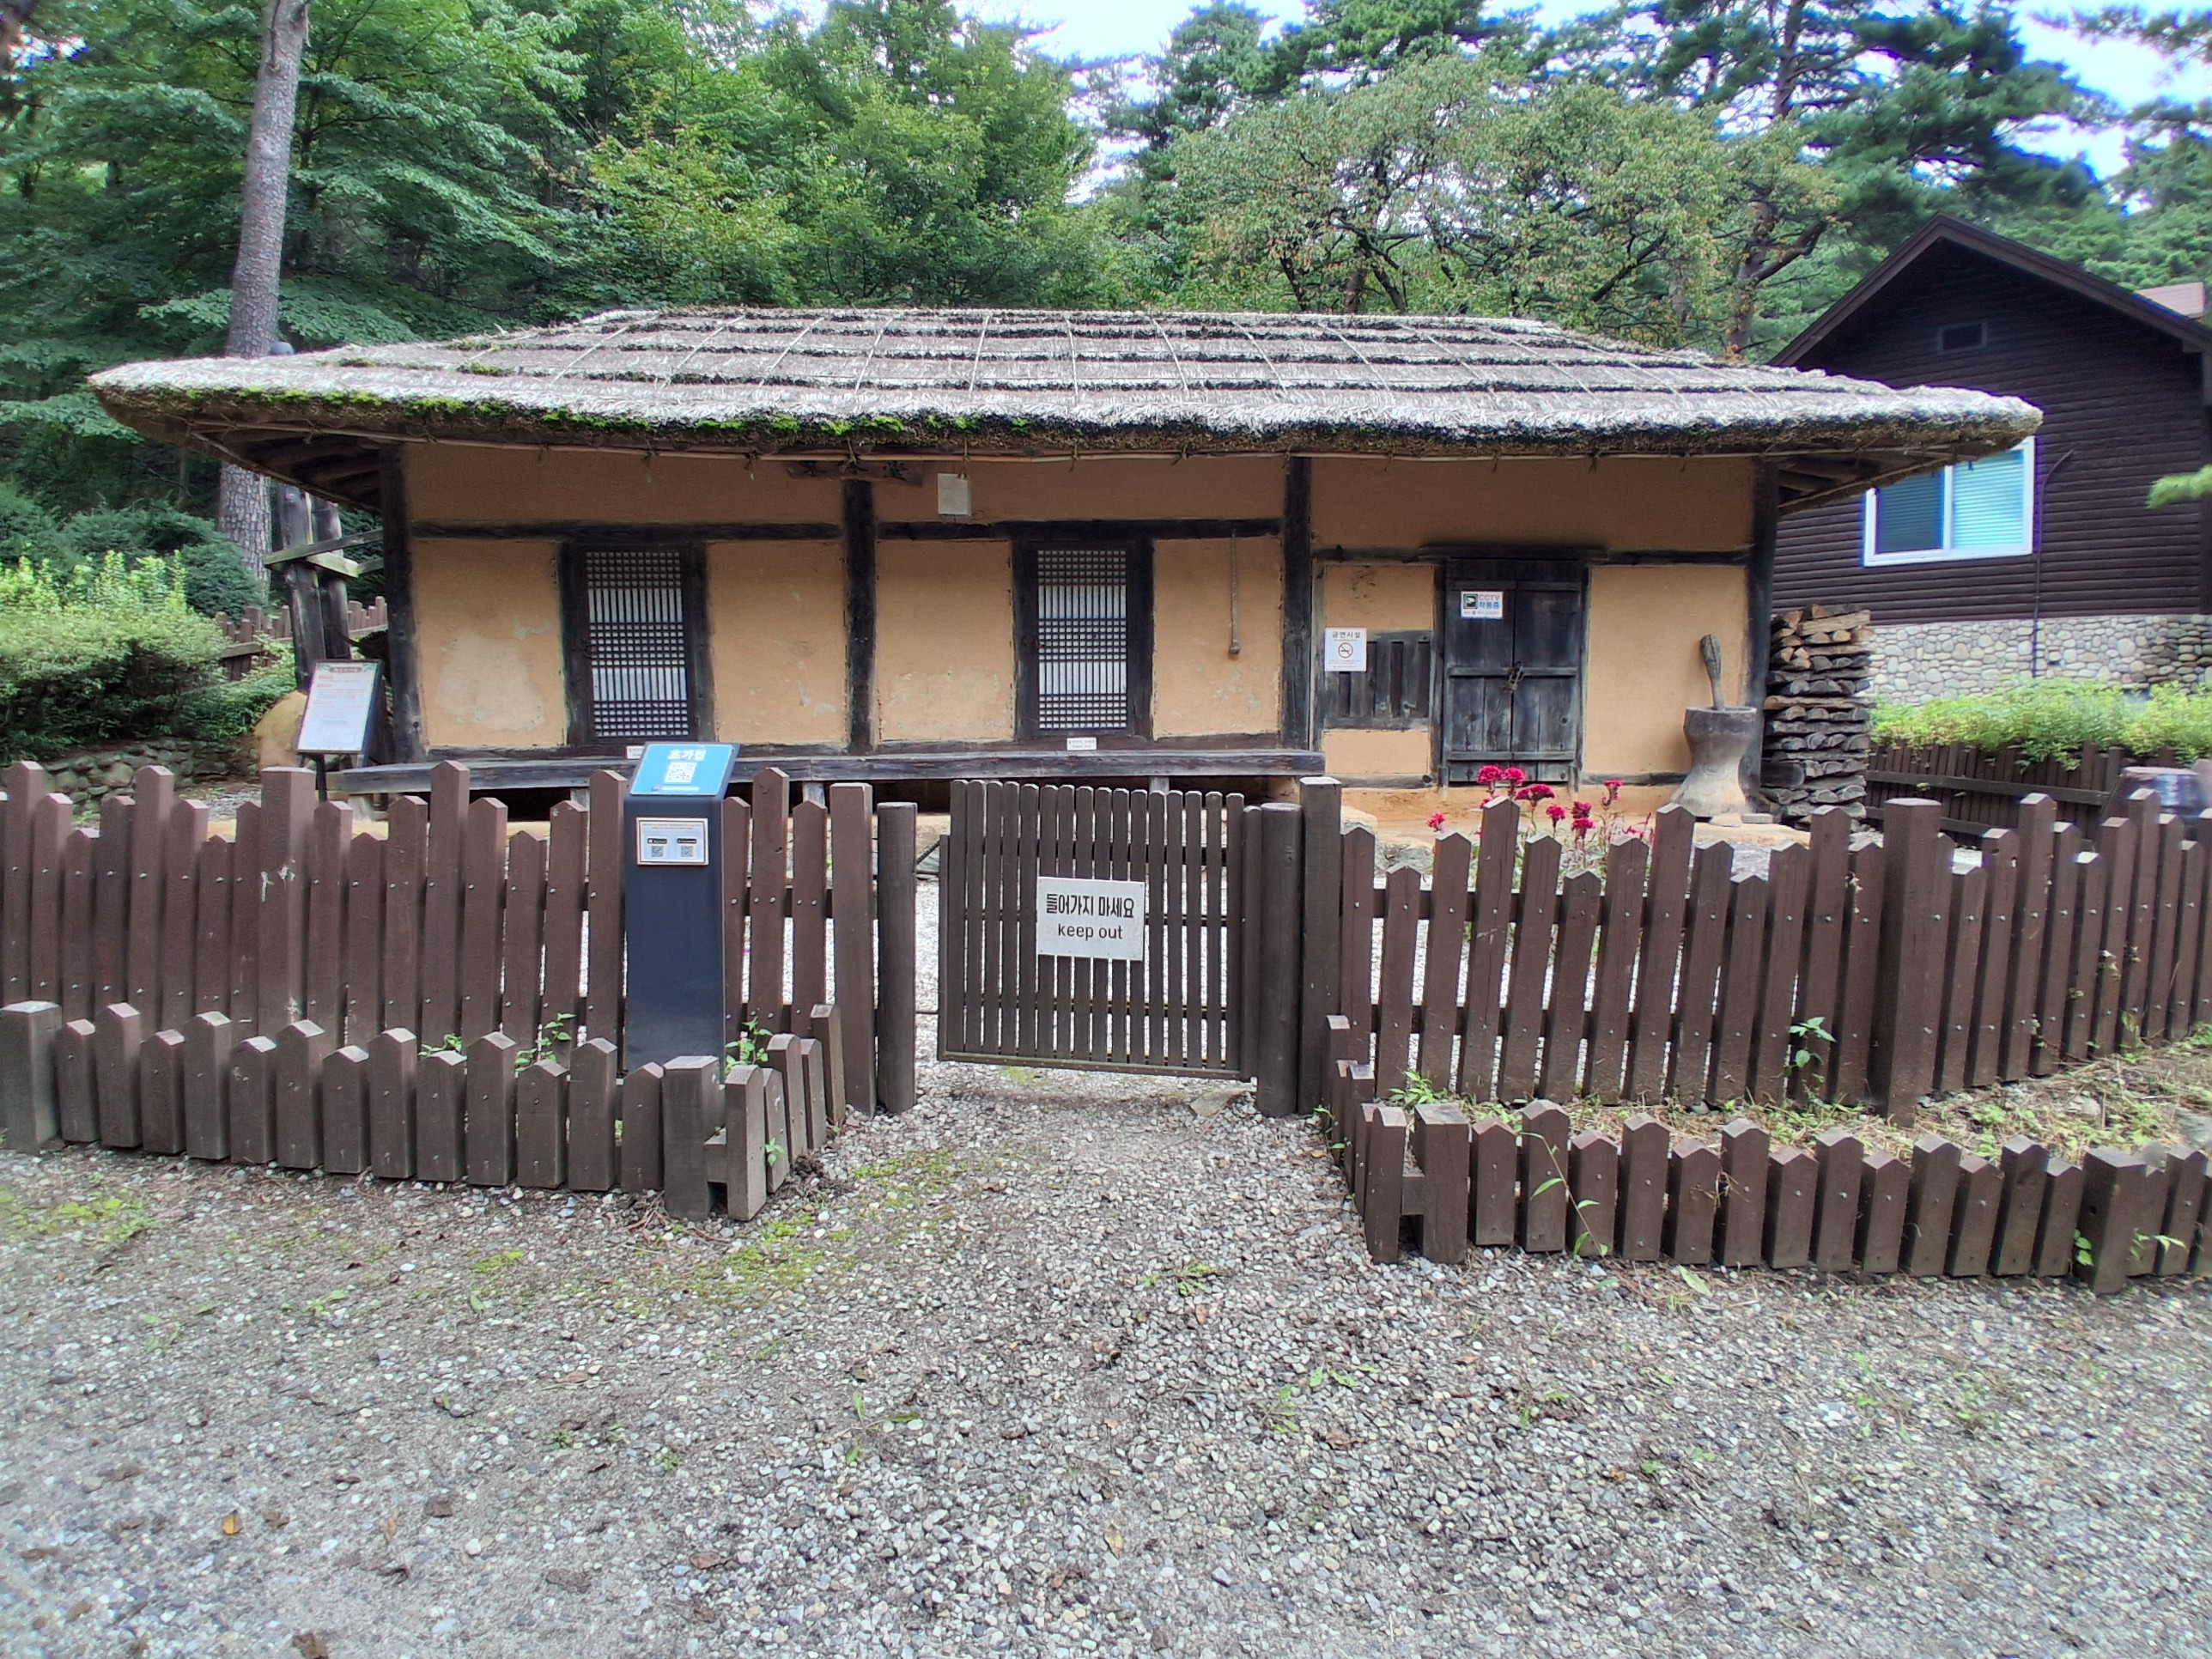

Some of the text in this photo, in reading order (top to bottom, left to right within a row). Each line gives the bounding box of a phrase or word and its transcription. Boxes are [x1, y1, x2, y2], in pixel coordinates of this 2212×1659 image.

[667, 749, 707, 761] 초가집
[1046, 893, 1134, 918] 들어가지 마세요
[1058, 923, 1123, 941] keep out
